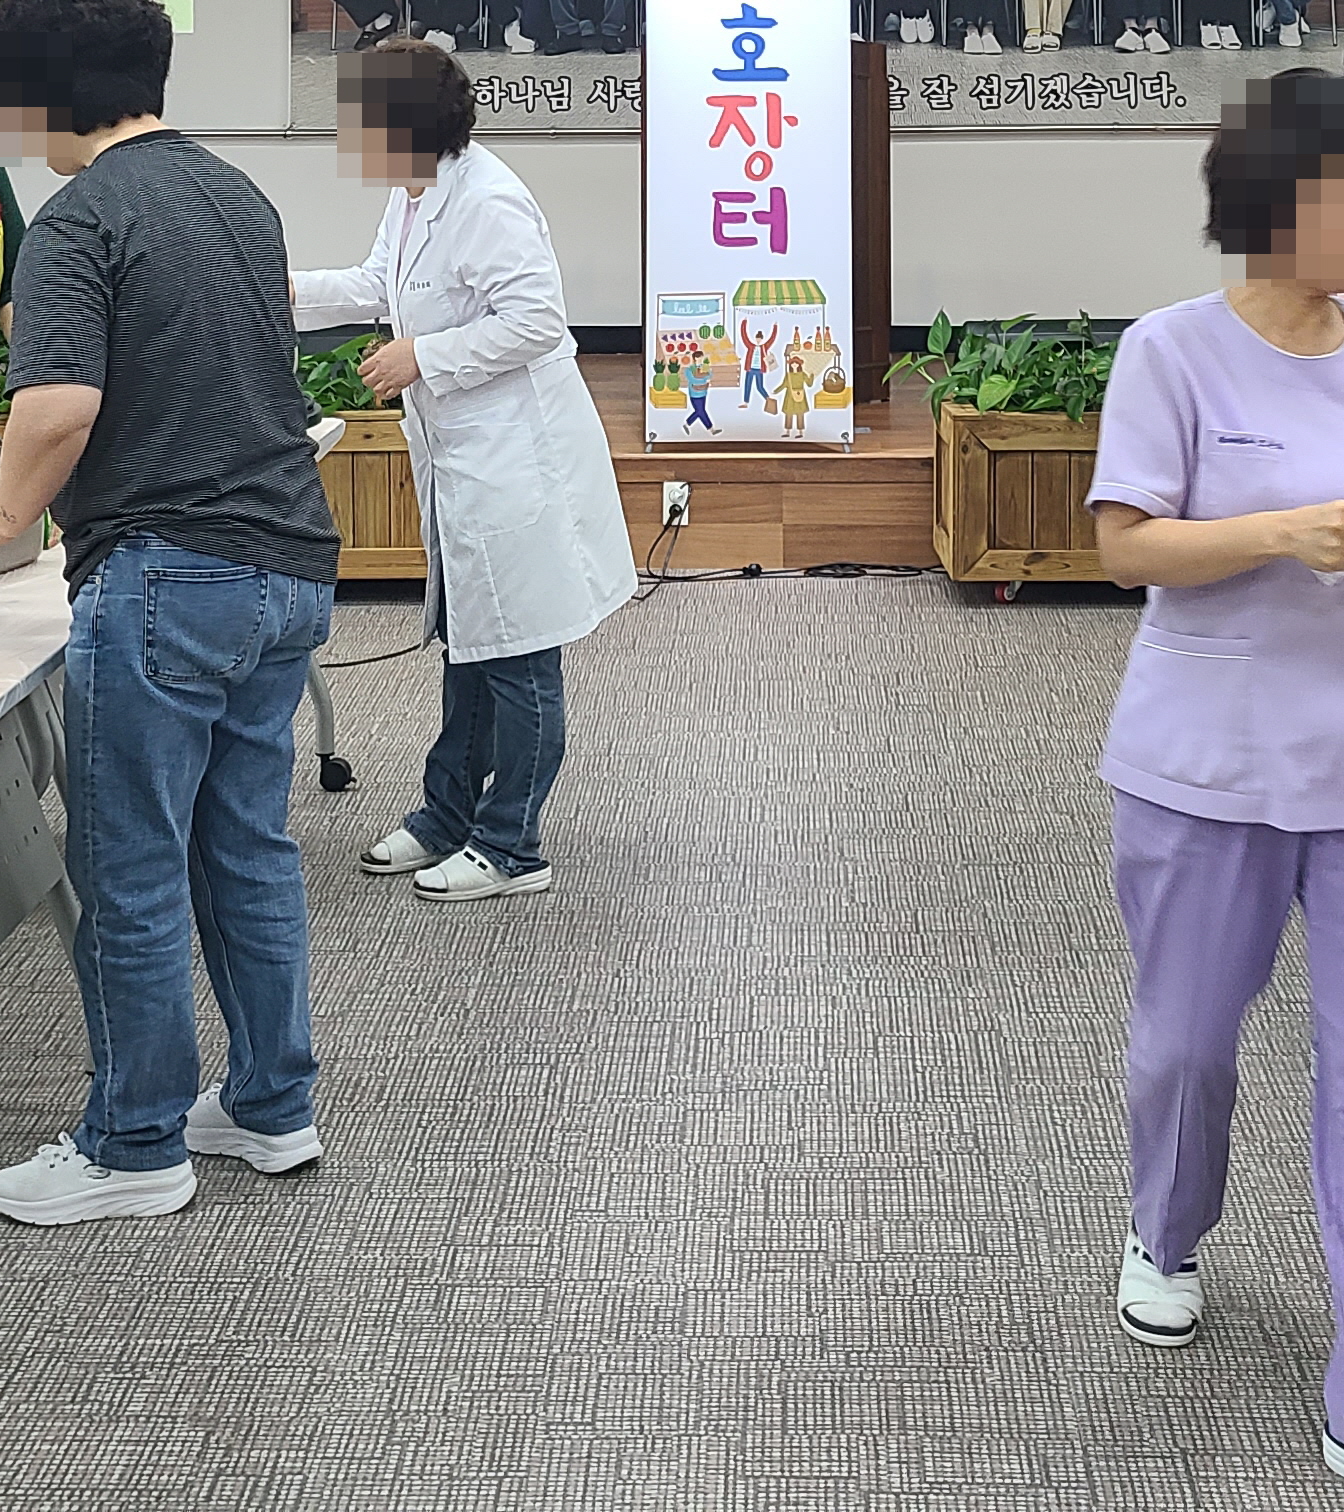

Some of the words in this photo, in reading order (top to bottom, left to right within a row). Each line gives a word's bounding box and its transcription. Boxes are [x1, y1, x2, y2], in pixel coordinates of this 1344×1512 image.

[473, 76, 573, 114] 하나님
[920, 74, 958, 111] 잘
[969, 71, 1188, 111] 섬기겠습니다.
